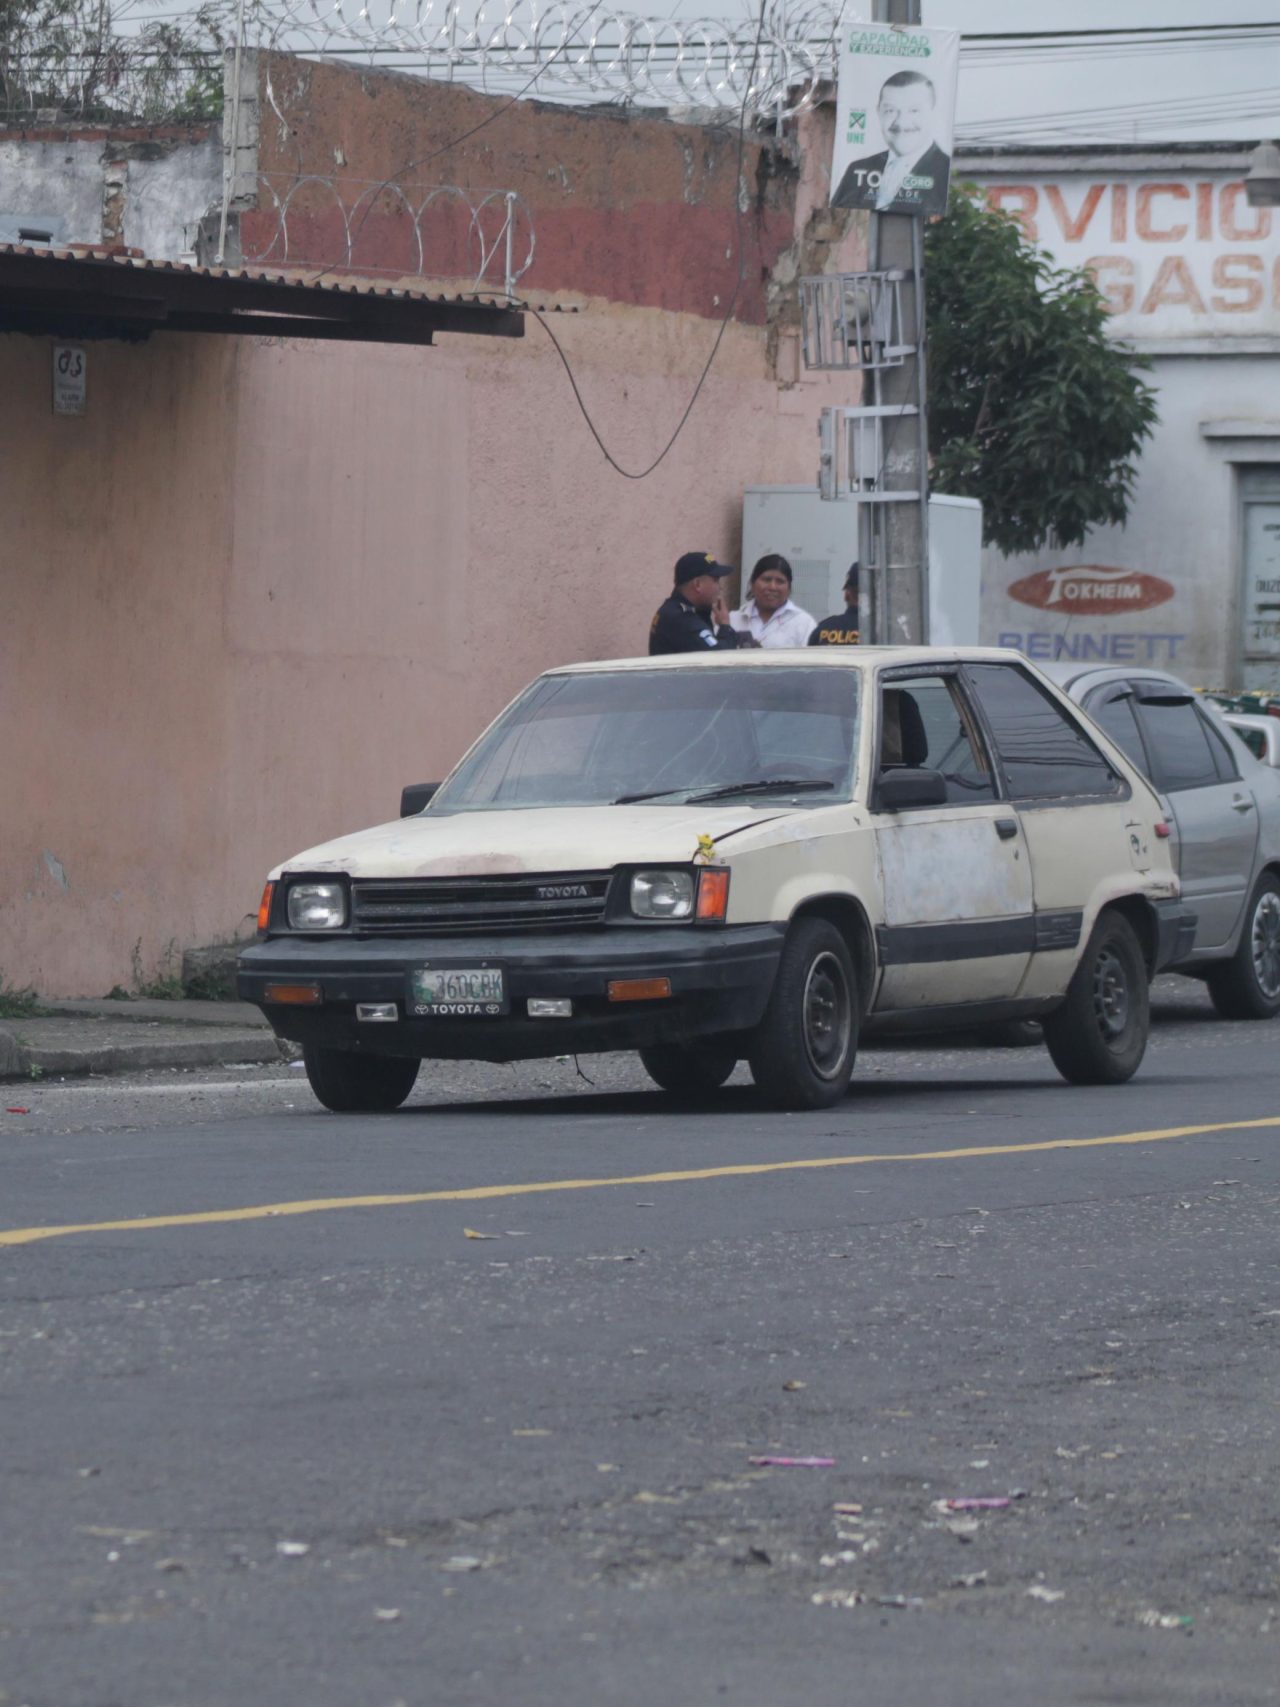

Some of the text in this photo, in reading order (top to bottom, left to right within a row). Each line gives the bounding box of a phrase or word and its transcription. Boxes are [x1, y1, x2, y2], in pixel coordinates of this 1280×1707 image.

[850, 31, 929, 47] CAPACIDAD
[850, 43, 925, 57] Y EXPERIENCIA
[984, 182, 1272, 243] RVICIO
[1046, 568, 1142, 606] TOKHEIM
[819, 629, 860, 644] POLIC
[998, 632, 1186, 660] BENNETT
[538, 886, 588, 898] TOYOTA
[431, 1004, 482, 1014] TOYOTA
